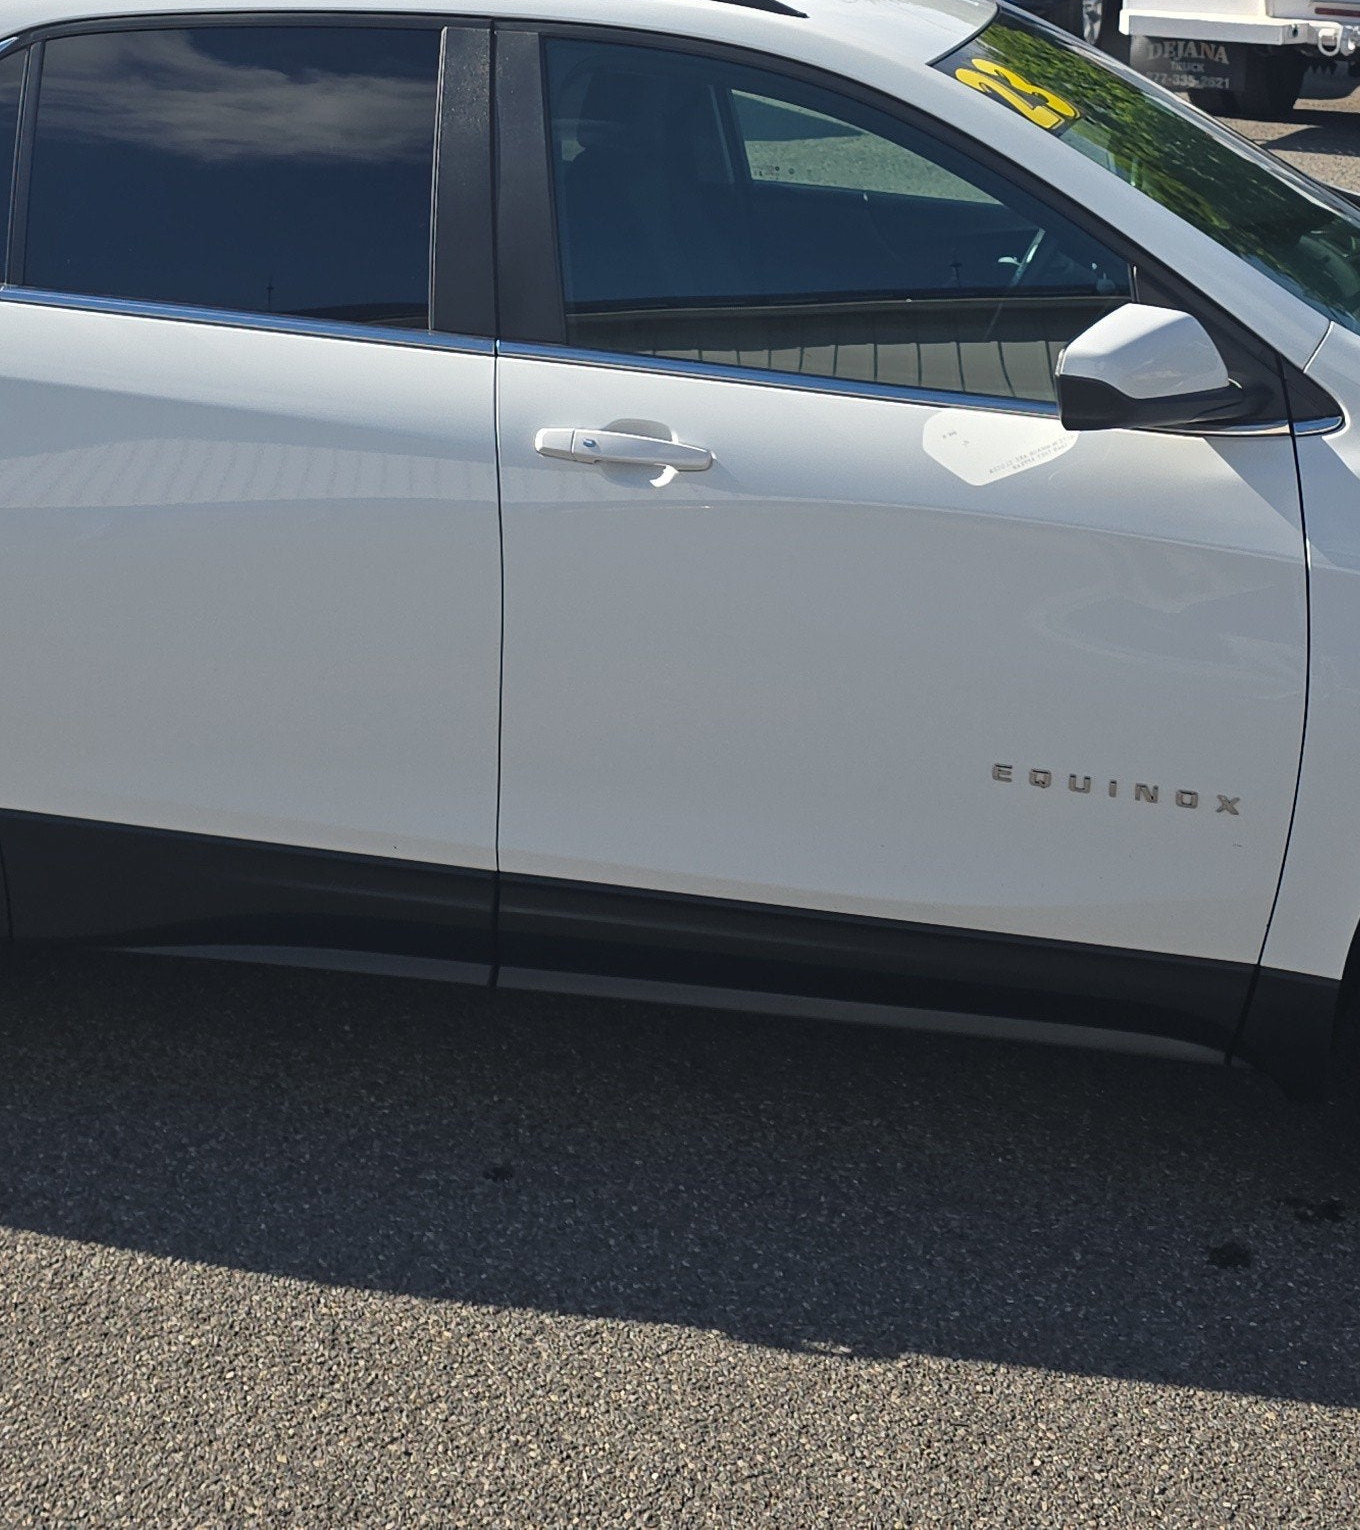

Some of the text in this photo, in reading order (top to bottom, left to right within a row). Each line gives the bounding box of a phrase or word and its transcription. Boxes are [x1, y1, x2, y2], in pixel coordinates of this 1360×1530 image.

[1148, 41, 1230, 65] DEJANA
[1171, 61, 1205, 73] TRUCK
[955, 58, 1081, 130] 23
[992, 763, 1241, 816] EQUINOX
